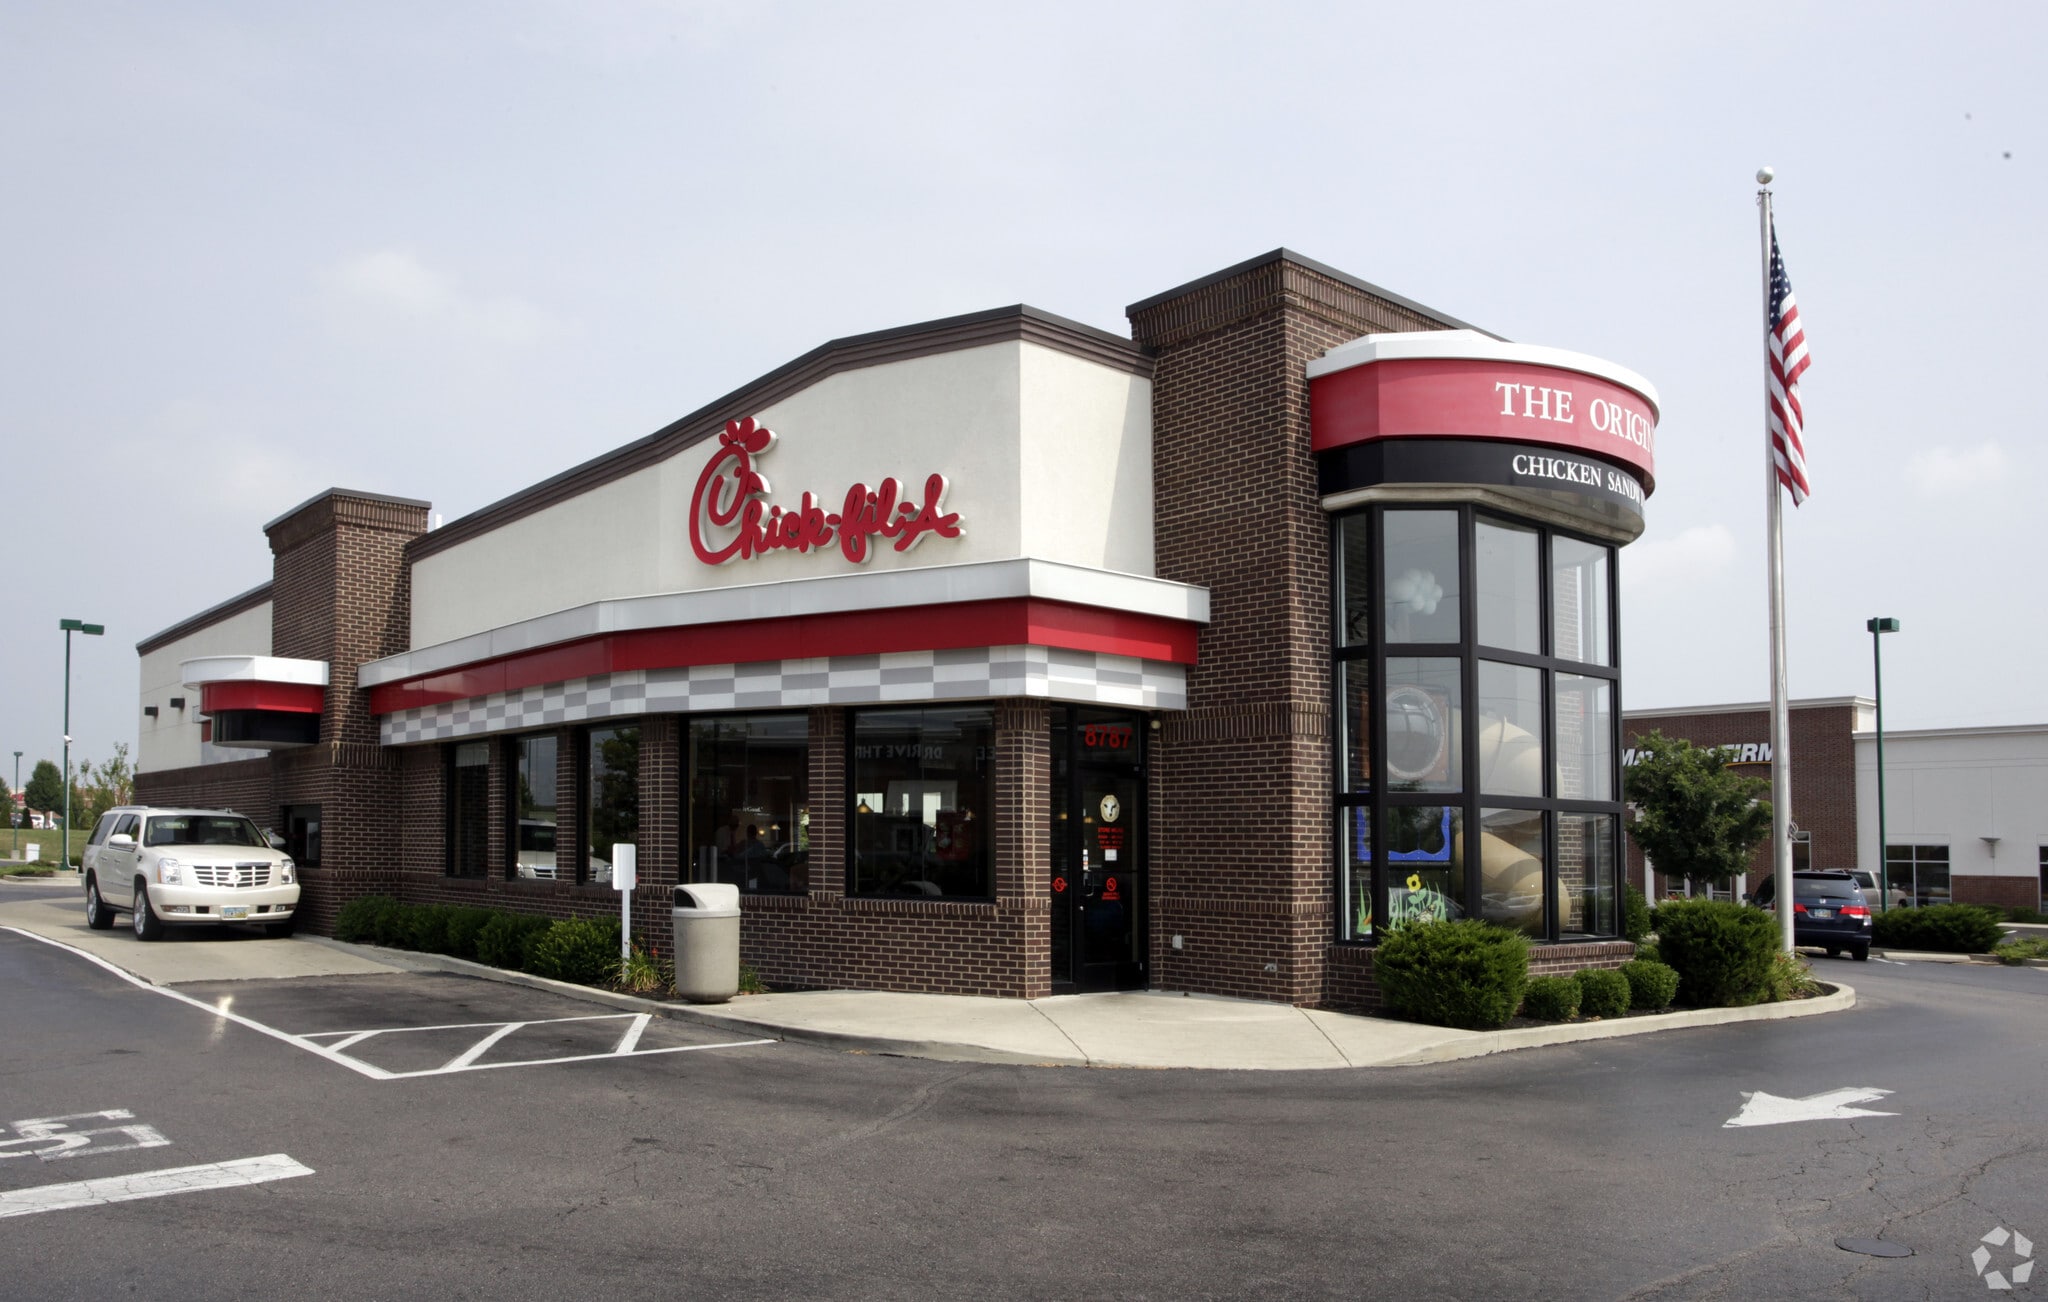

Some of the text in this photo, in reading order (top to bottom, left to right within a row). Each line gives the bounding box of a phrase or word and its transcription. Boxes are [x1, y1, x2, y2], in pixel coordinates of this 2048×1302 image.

[1495, 381, 1574, 424] THE
[1512, 454, 1602, 487] CHICKEN
[689, 416, 966, 565] Chick-fil-A
[1084, 723, 1133, 750] 8787
